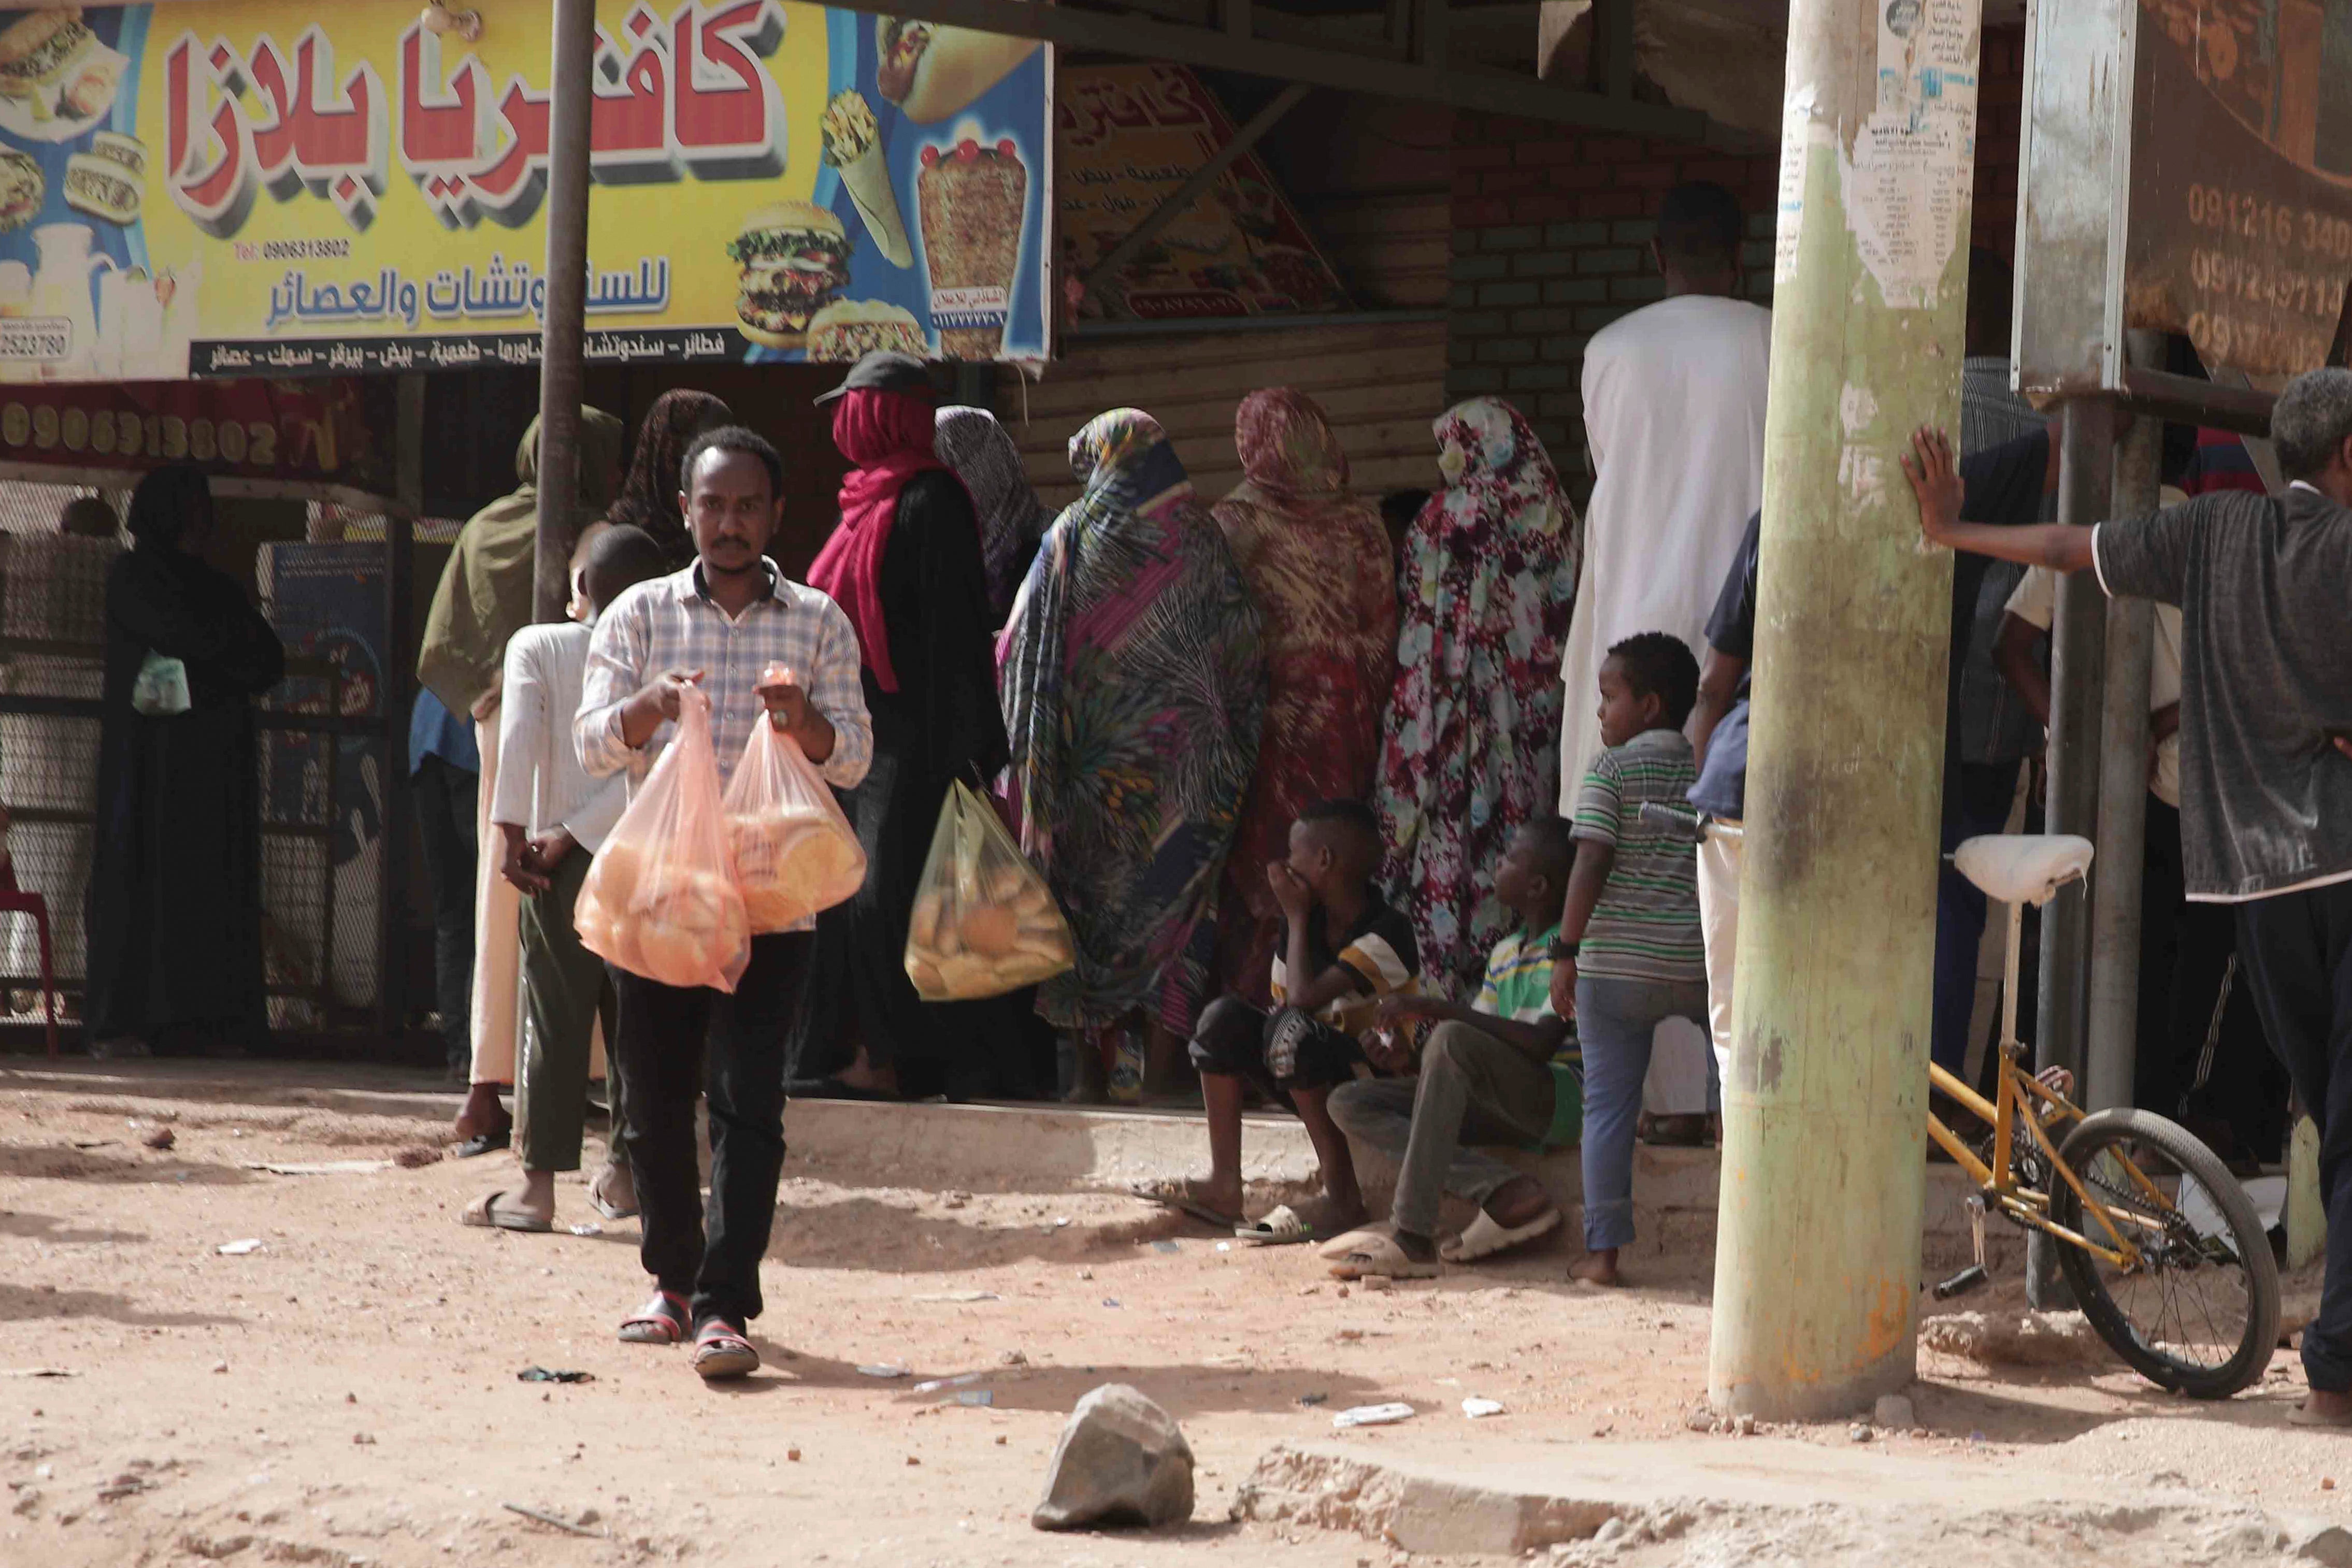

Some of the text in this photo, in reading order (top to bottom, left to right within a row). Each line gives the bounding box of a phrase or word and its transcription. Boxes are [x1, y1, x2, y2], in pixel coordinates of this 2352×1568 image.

[166, 22, 388, 240] بلازا
[266, 270, 418, 329] والعصائر
[209, 343, 252, 372] عصائر
[267, 341, 313, 368] سمك
[379, 341, 413, 368] بيض
[682, 332, 725, 359] فطائر
[2, 401, 277, 466] 0906313802
